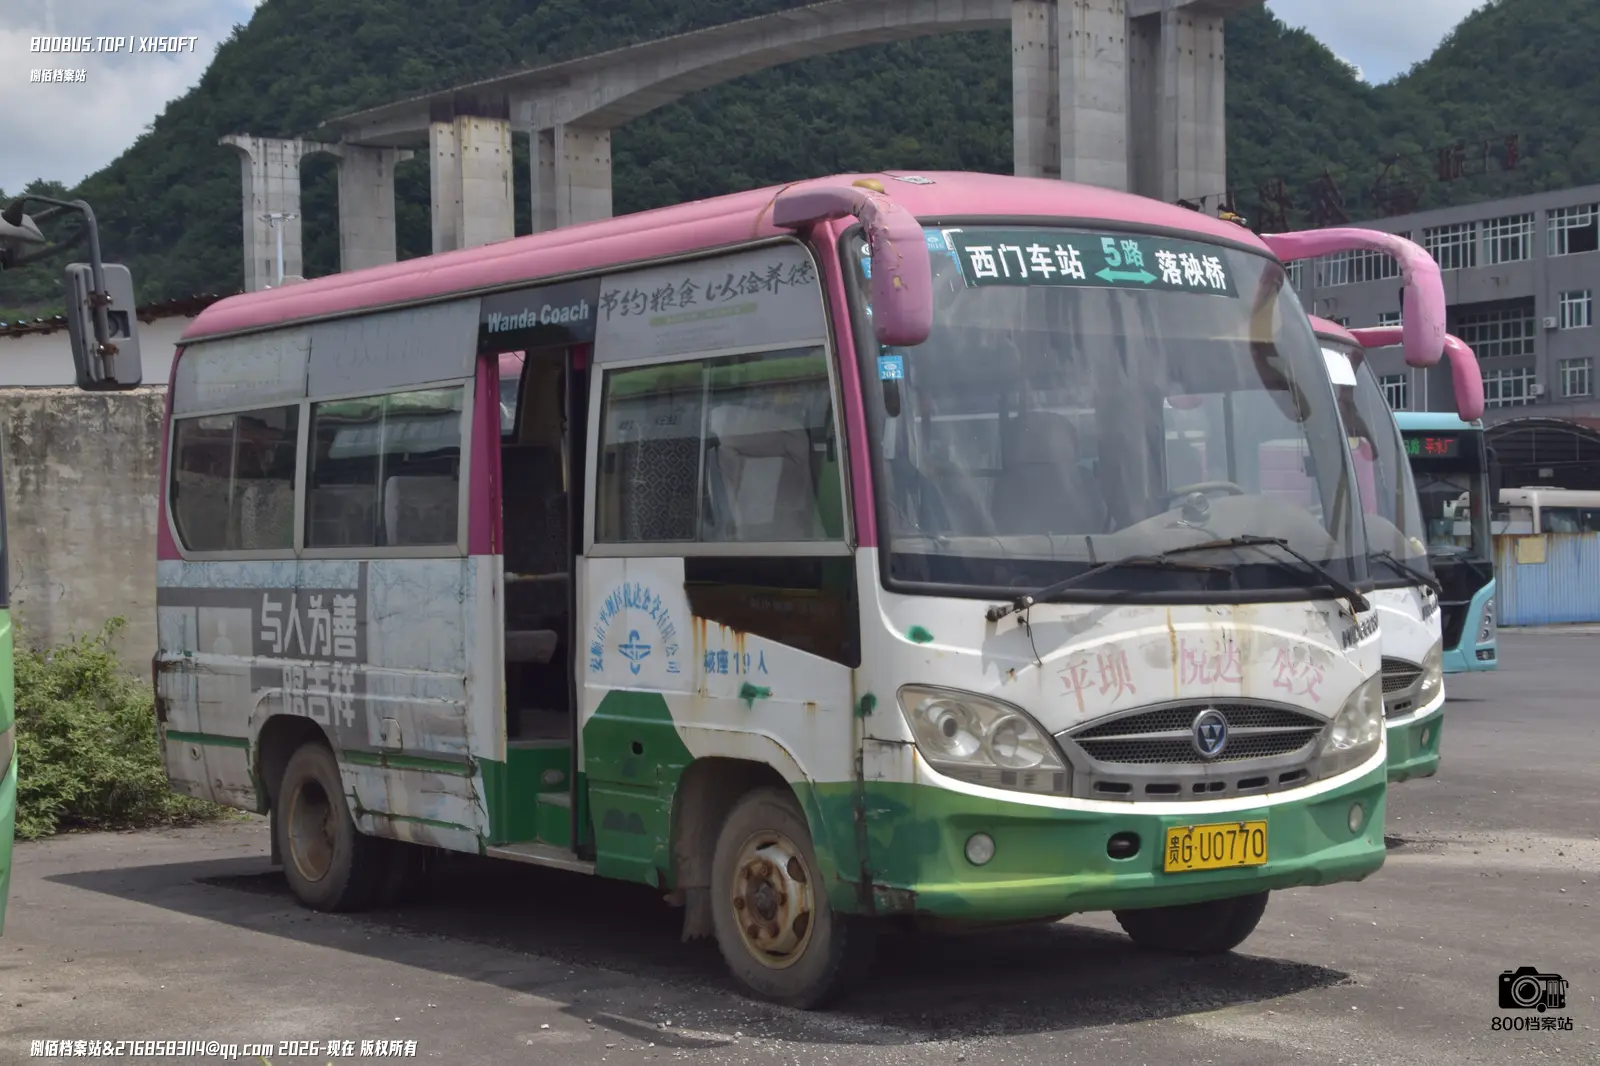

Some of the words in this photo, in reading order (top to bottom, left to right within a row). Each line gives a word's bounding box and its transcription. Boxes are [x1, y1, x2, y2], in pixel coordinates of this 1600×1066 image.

[600, 278, 700, 321] 节约粮食
[706, 260, 815, 303] 以俭养德
[965, 244, 1086, 280] 西门车站
[1101, 237, 1145, 267] 5路
[1154, 249, 1227, 290] 落秧桥
[488, 310, 537, 333] Wanda
[540, 301, 589, 325] Coach
[261, 592, 357, 658] 与人为善
[1056, 648, 1137, 714] 平坝
[1180, 637, 1244, 686] 悦达
[1272, 646, 1326, 704] 公交
